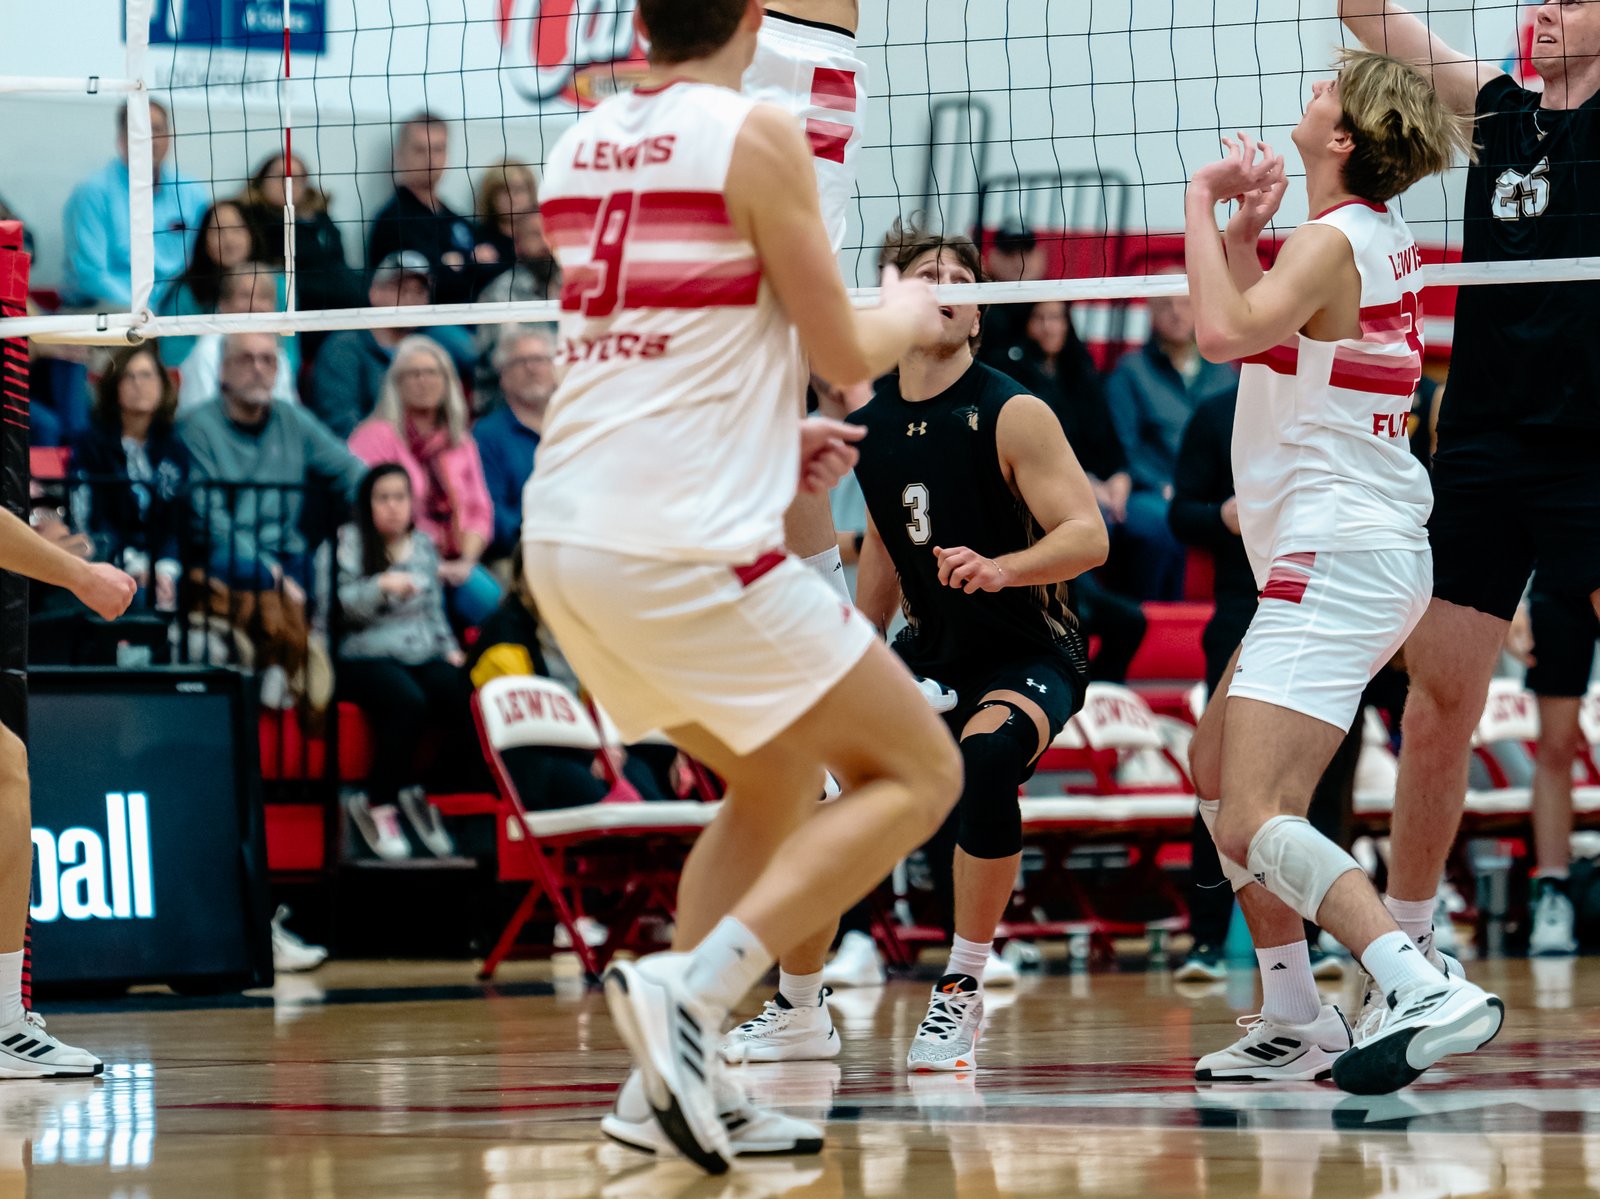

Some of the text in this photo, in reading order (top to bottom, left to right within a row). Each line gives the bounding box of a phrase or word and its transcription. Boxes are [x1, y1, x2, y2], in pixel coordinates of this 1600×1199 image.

[572, 134, 677, 171] LEWIS
[1491, 156, 1550, 221] 25
[581, 190, 636, 318] 9
[902, 483, 932, 545] 3
[495, 688, 577, 725] LEWIS
